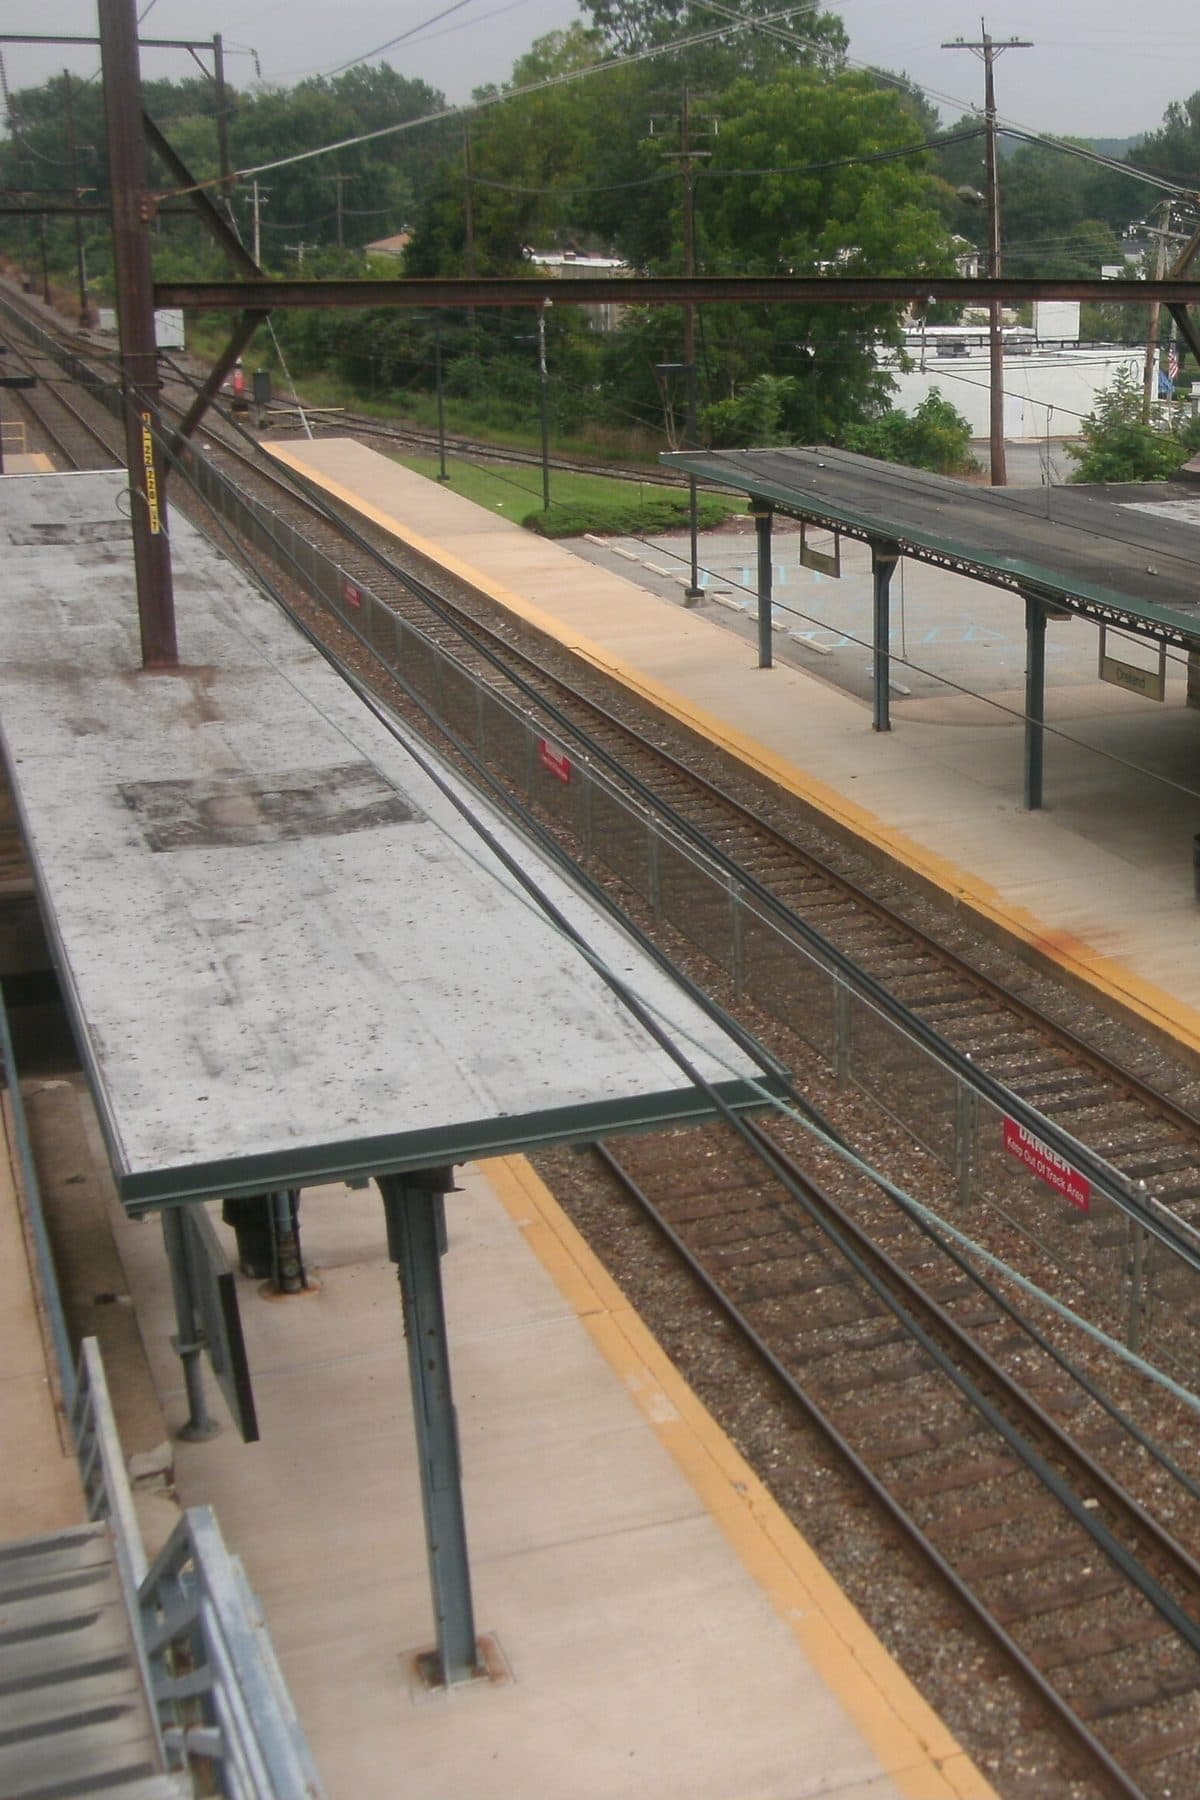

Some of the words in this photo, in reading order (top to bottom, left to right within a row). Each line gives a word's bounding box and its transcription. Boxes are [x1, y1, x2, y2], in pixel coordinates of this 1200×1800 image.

[1007, 1136, 1024, 1157] Keep
[1024, 1149, 1037, 1168] Out
[1037, 1158, 1046, 1174] Of
[1045, 1166, 1066, 1190] Track
[1066, 1182, 1085, 1204] Area
[1018, 1125, 1072, 1176] DANGER
